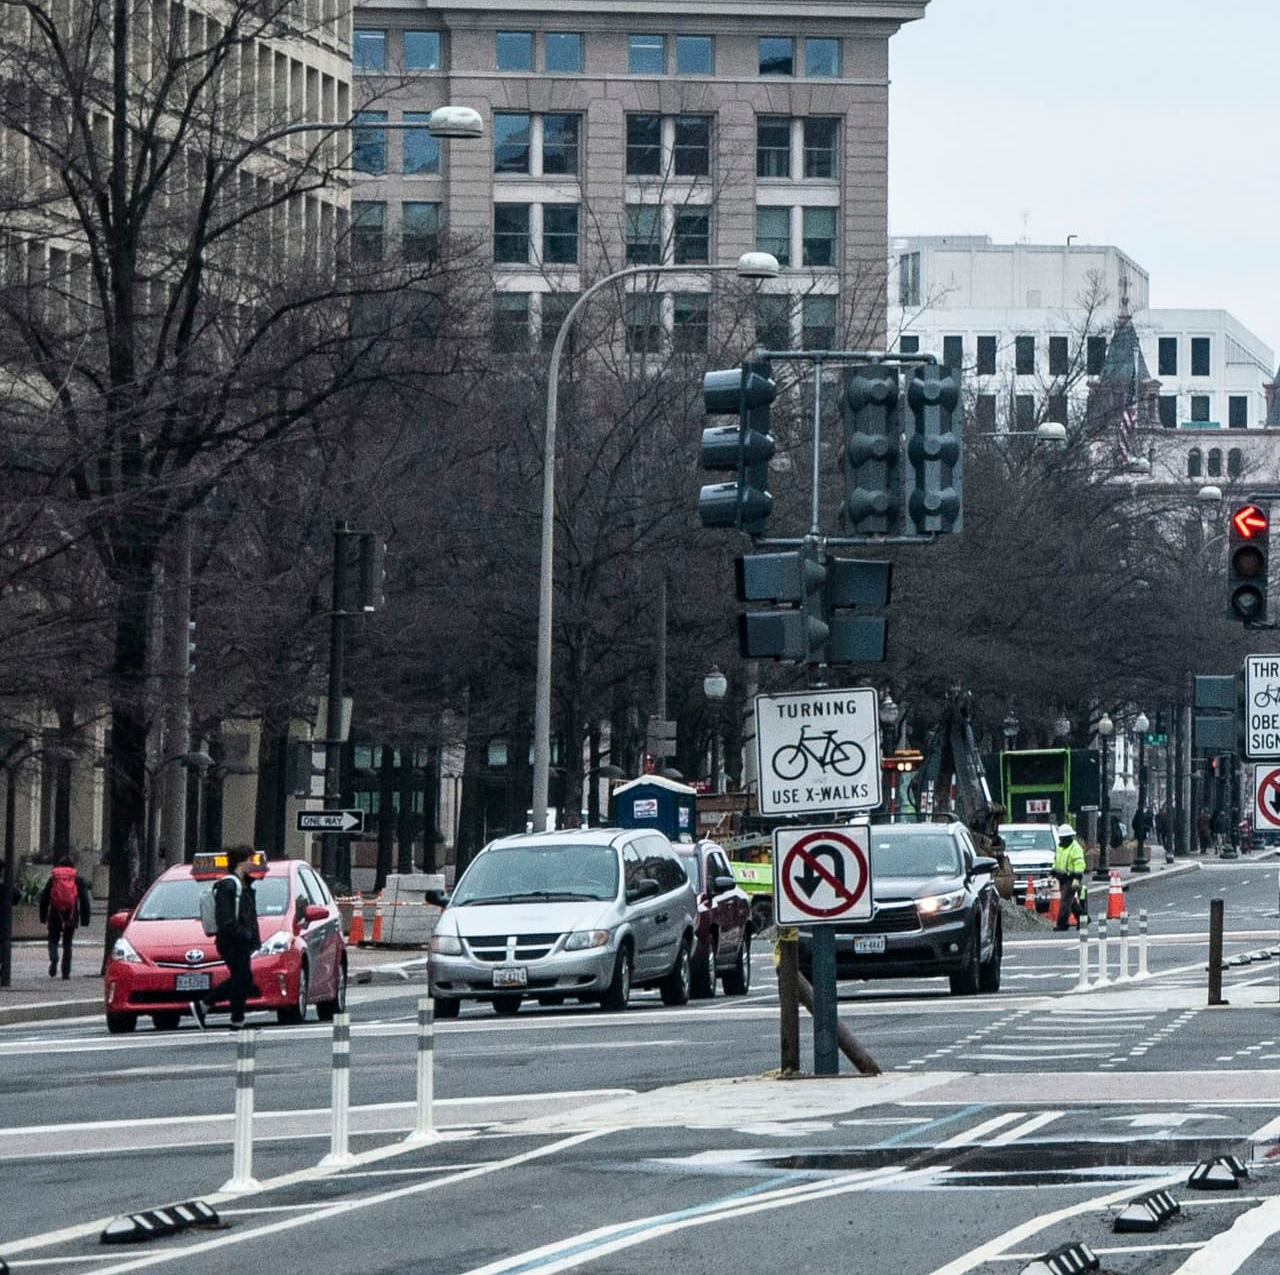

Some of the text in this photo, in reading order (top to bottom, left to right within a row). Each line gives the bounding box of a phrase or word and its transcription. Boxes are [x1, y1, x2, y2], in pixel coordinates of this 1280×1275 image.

[777, 700, 857, 718] TURNING
[772, 783, 869, 804] USE X-WALKS
[303, 816, 343, 825] ONE WAY
